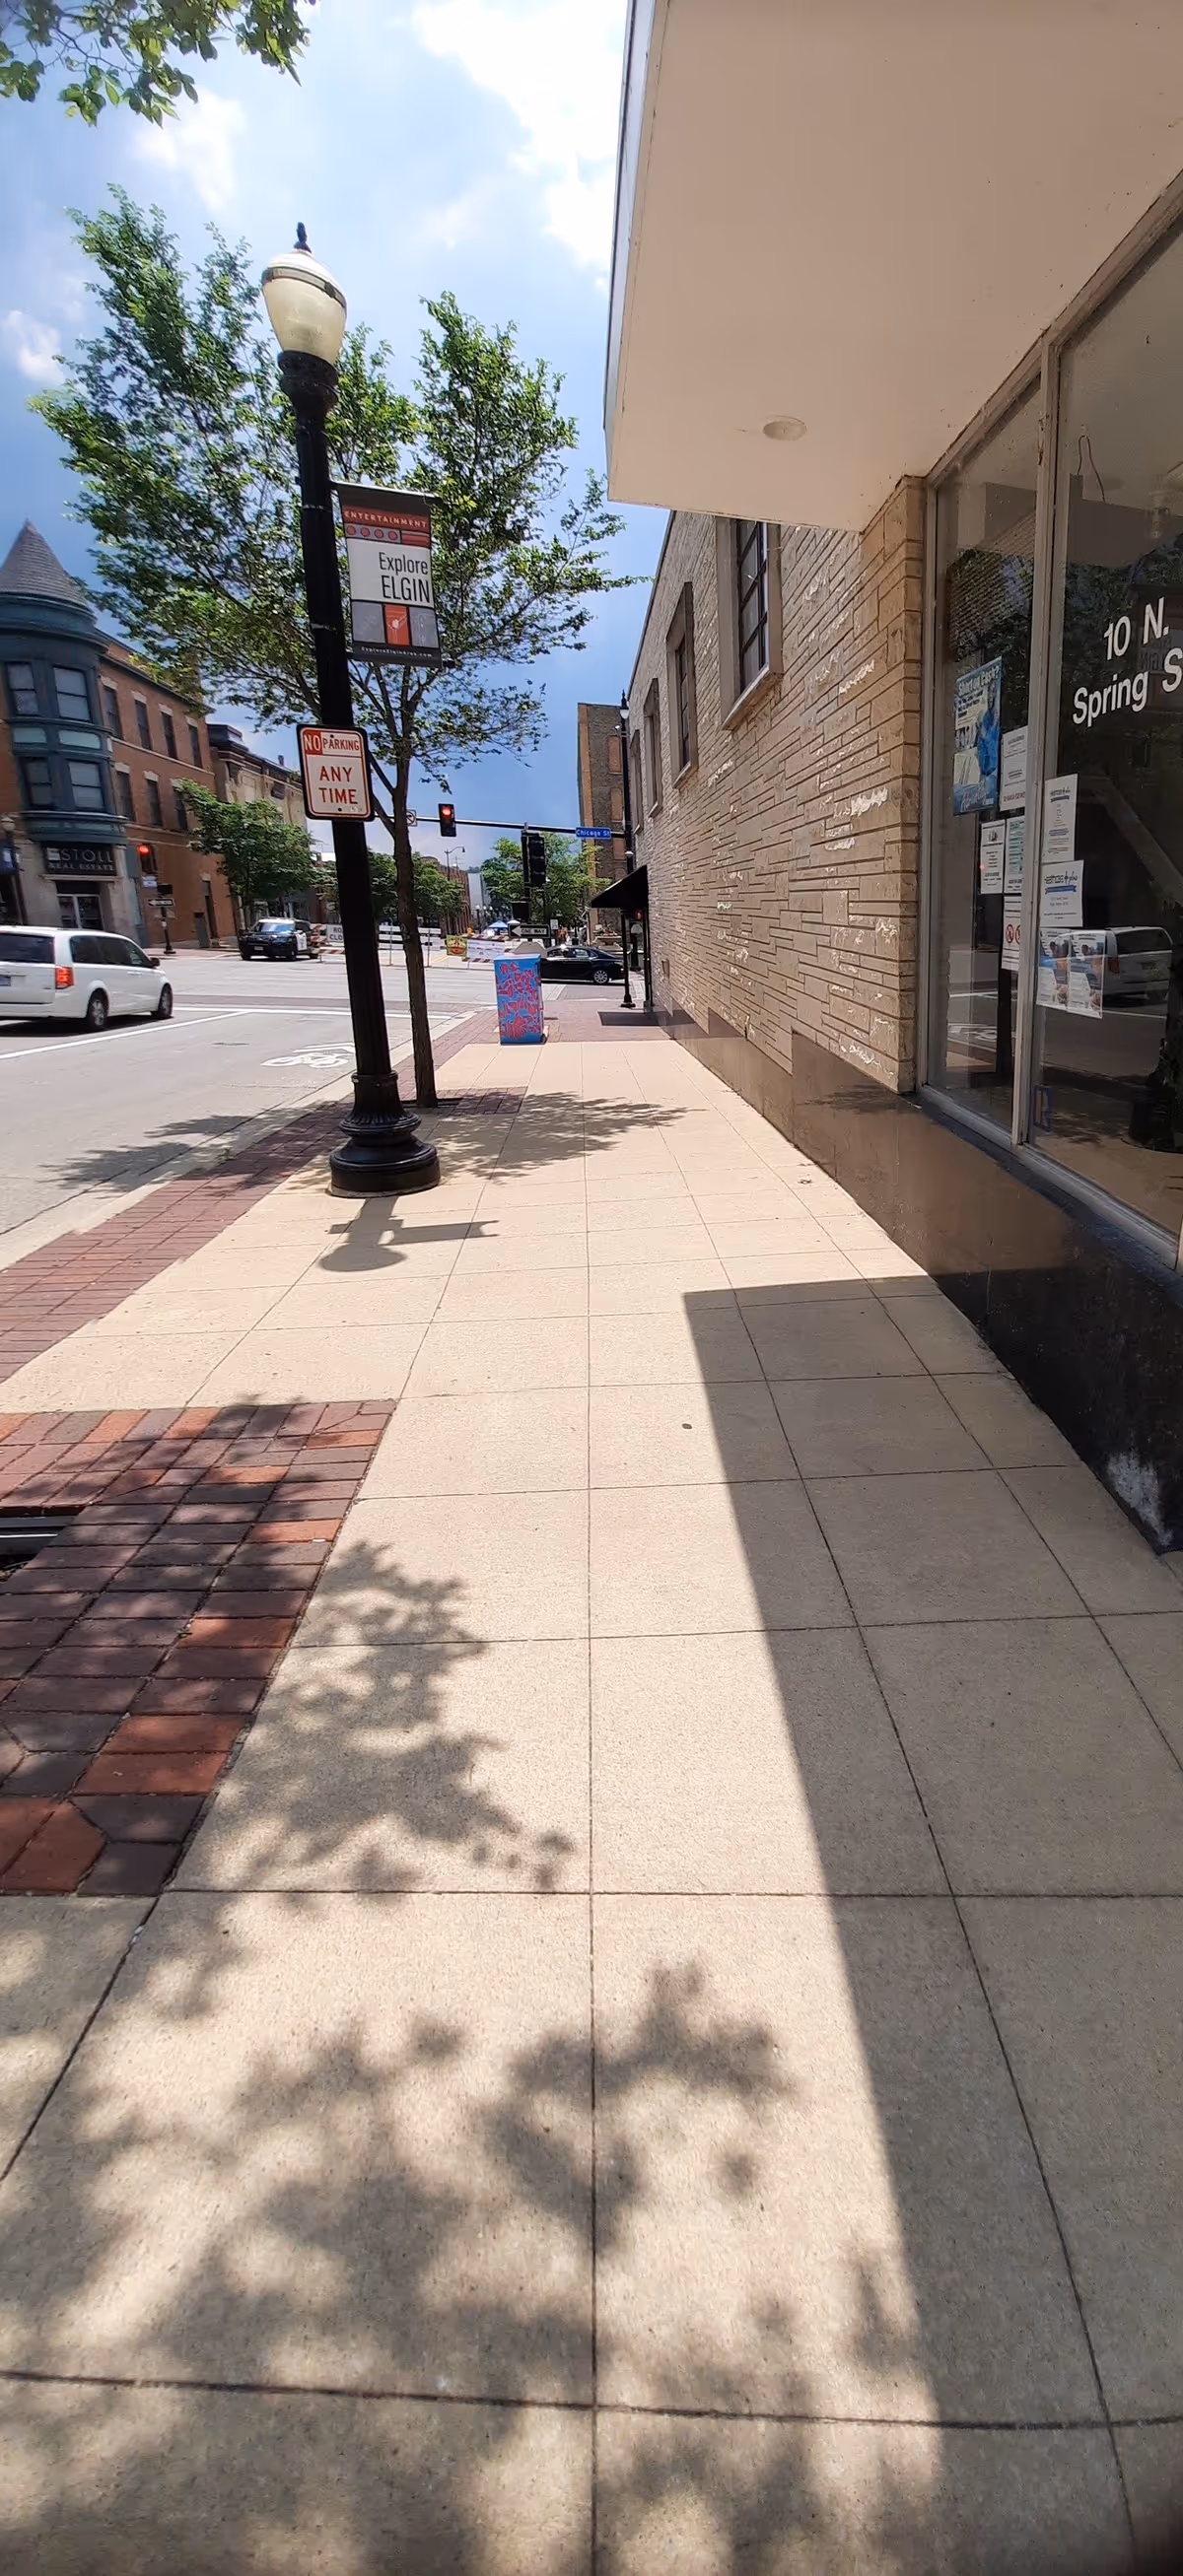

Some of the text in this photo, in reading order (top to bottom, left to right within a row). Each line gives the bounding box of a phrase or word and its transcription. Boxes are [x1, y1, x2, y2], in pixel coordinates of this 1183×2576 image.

[345, 509, 427, 529] ENTERTAINMENT
[379, 552, 428, 576] Explore
[381, 576, 431, 603] ELGIN
[1103, 596, 1169, 661] 10 N.
[1072, 647, 1183, 727] Spring S
[304, 734, 360, 751] NO PARKING
[319, 766, 353, 782] ANY
[318, 787, 359, 804] TIME
[60, 847, 113, 863] STOLL
